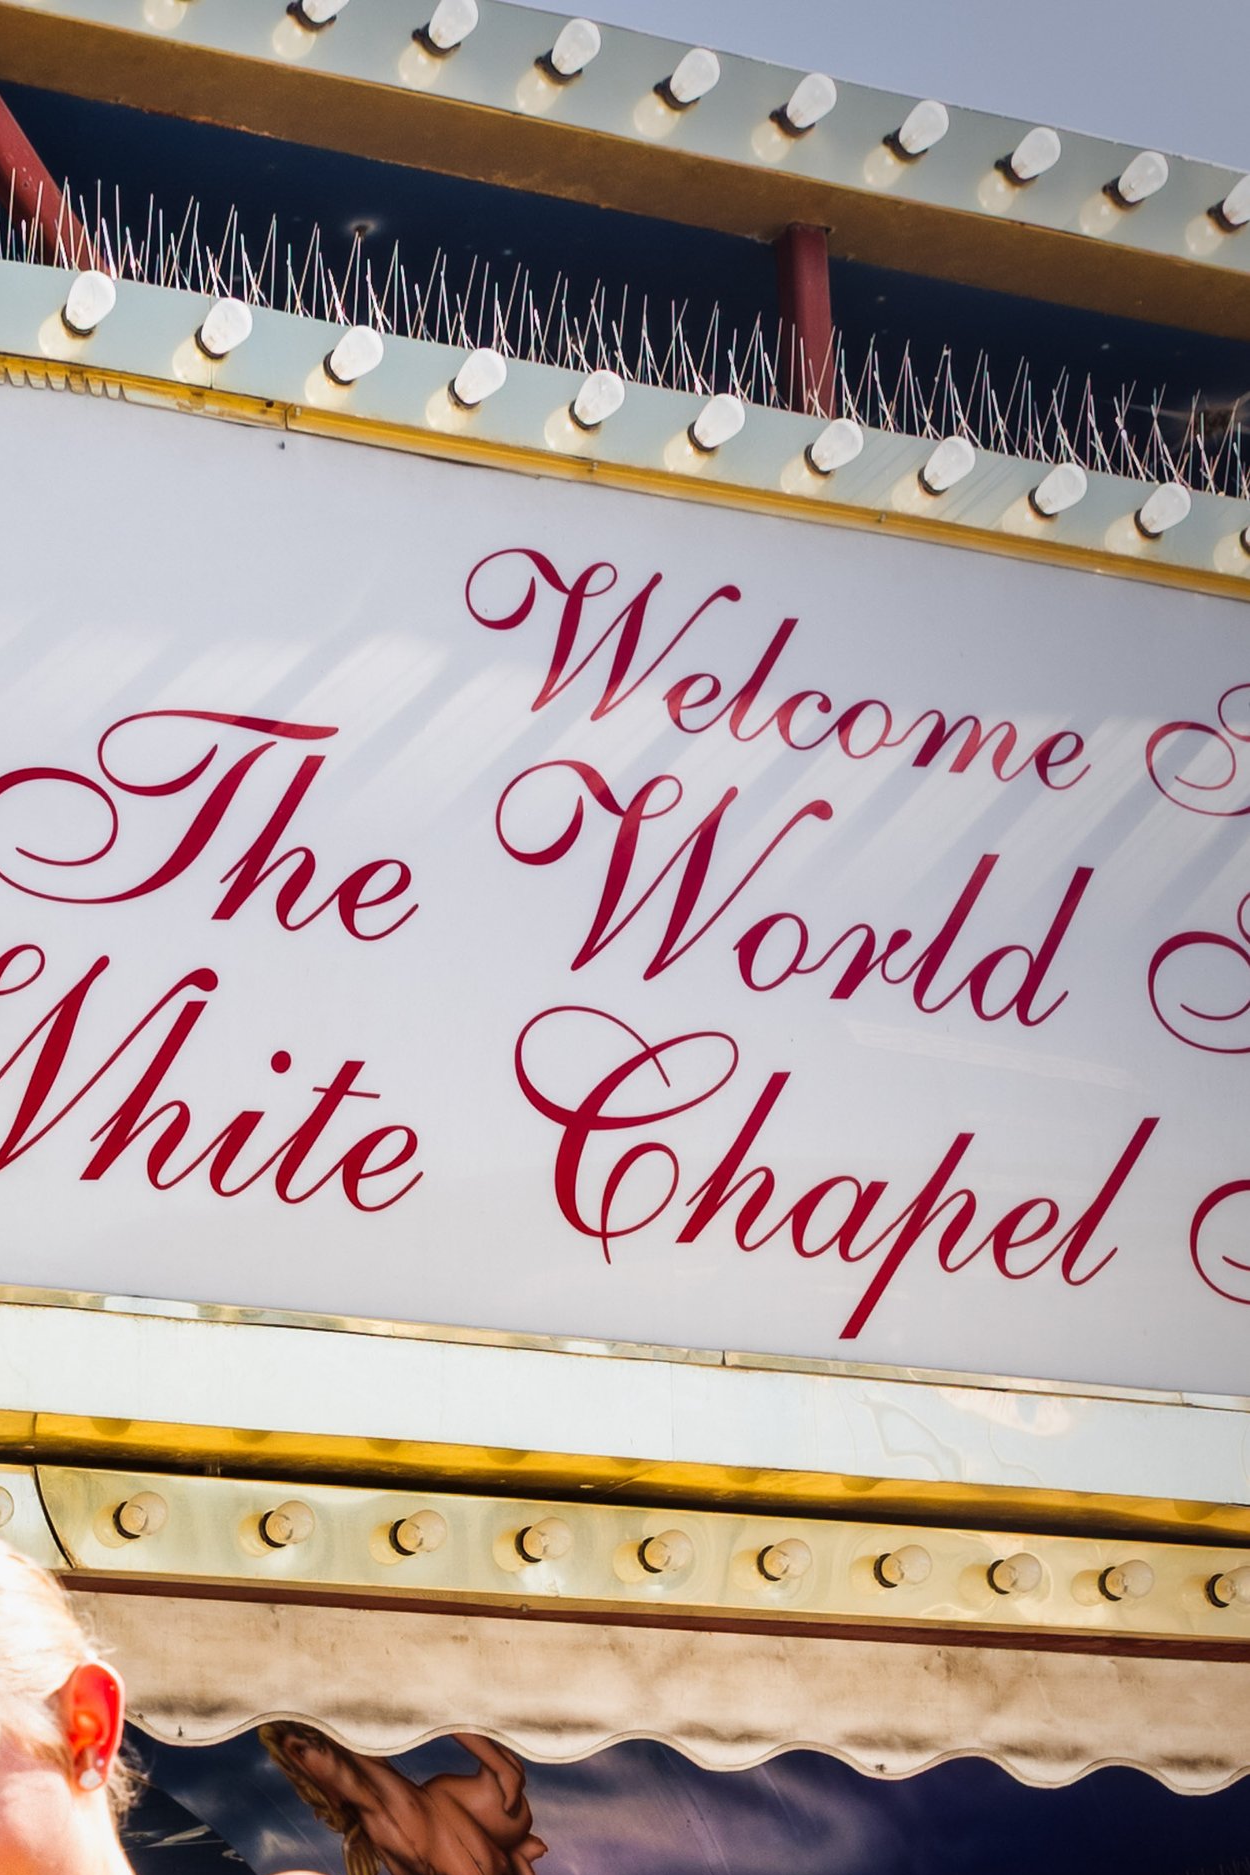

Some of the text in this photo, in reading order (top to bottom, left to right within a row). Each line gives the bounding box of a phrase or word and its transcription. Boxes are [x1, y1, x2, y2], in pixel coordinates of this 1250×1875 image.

[465, 547, 1091, 790] Welcome
[495, 759, 1095, 1027] World
[514, 1005, 1161, 1340] Chapel
